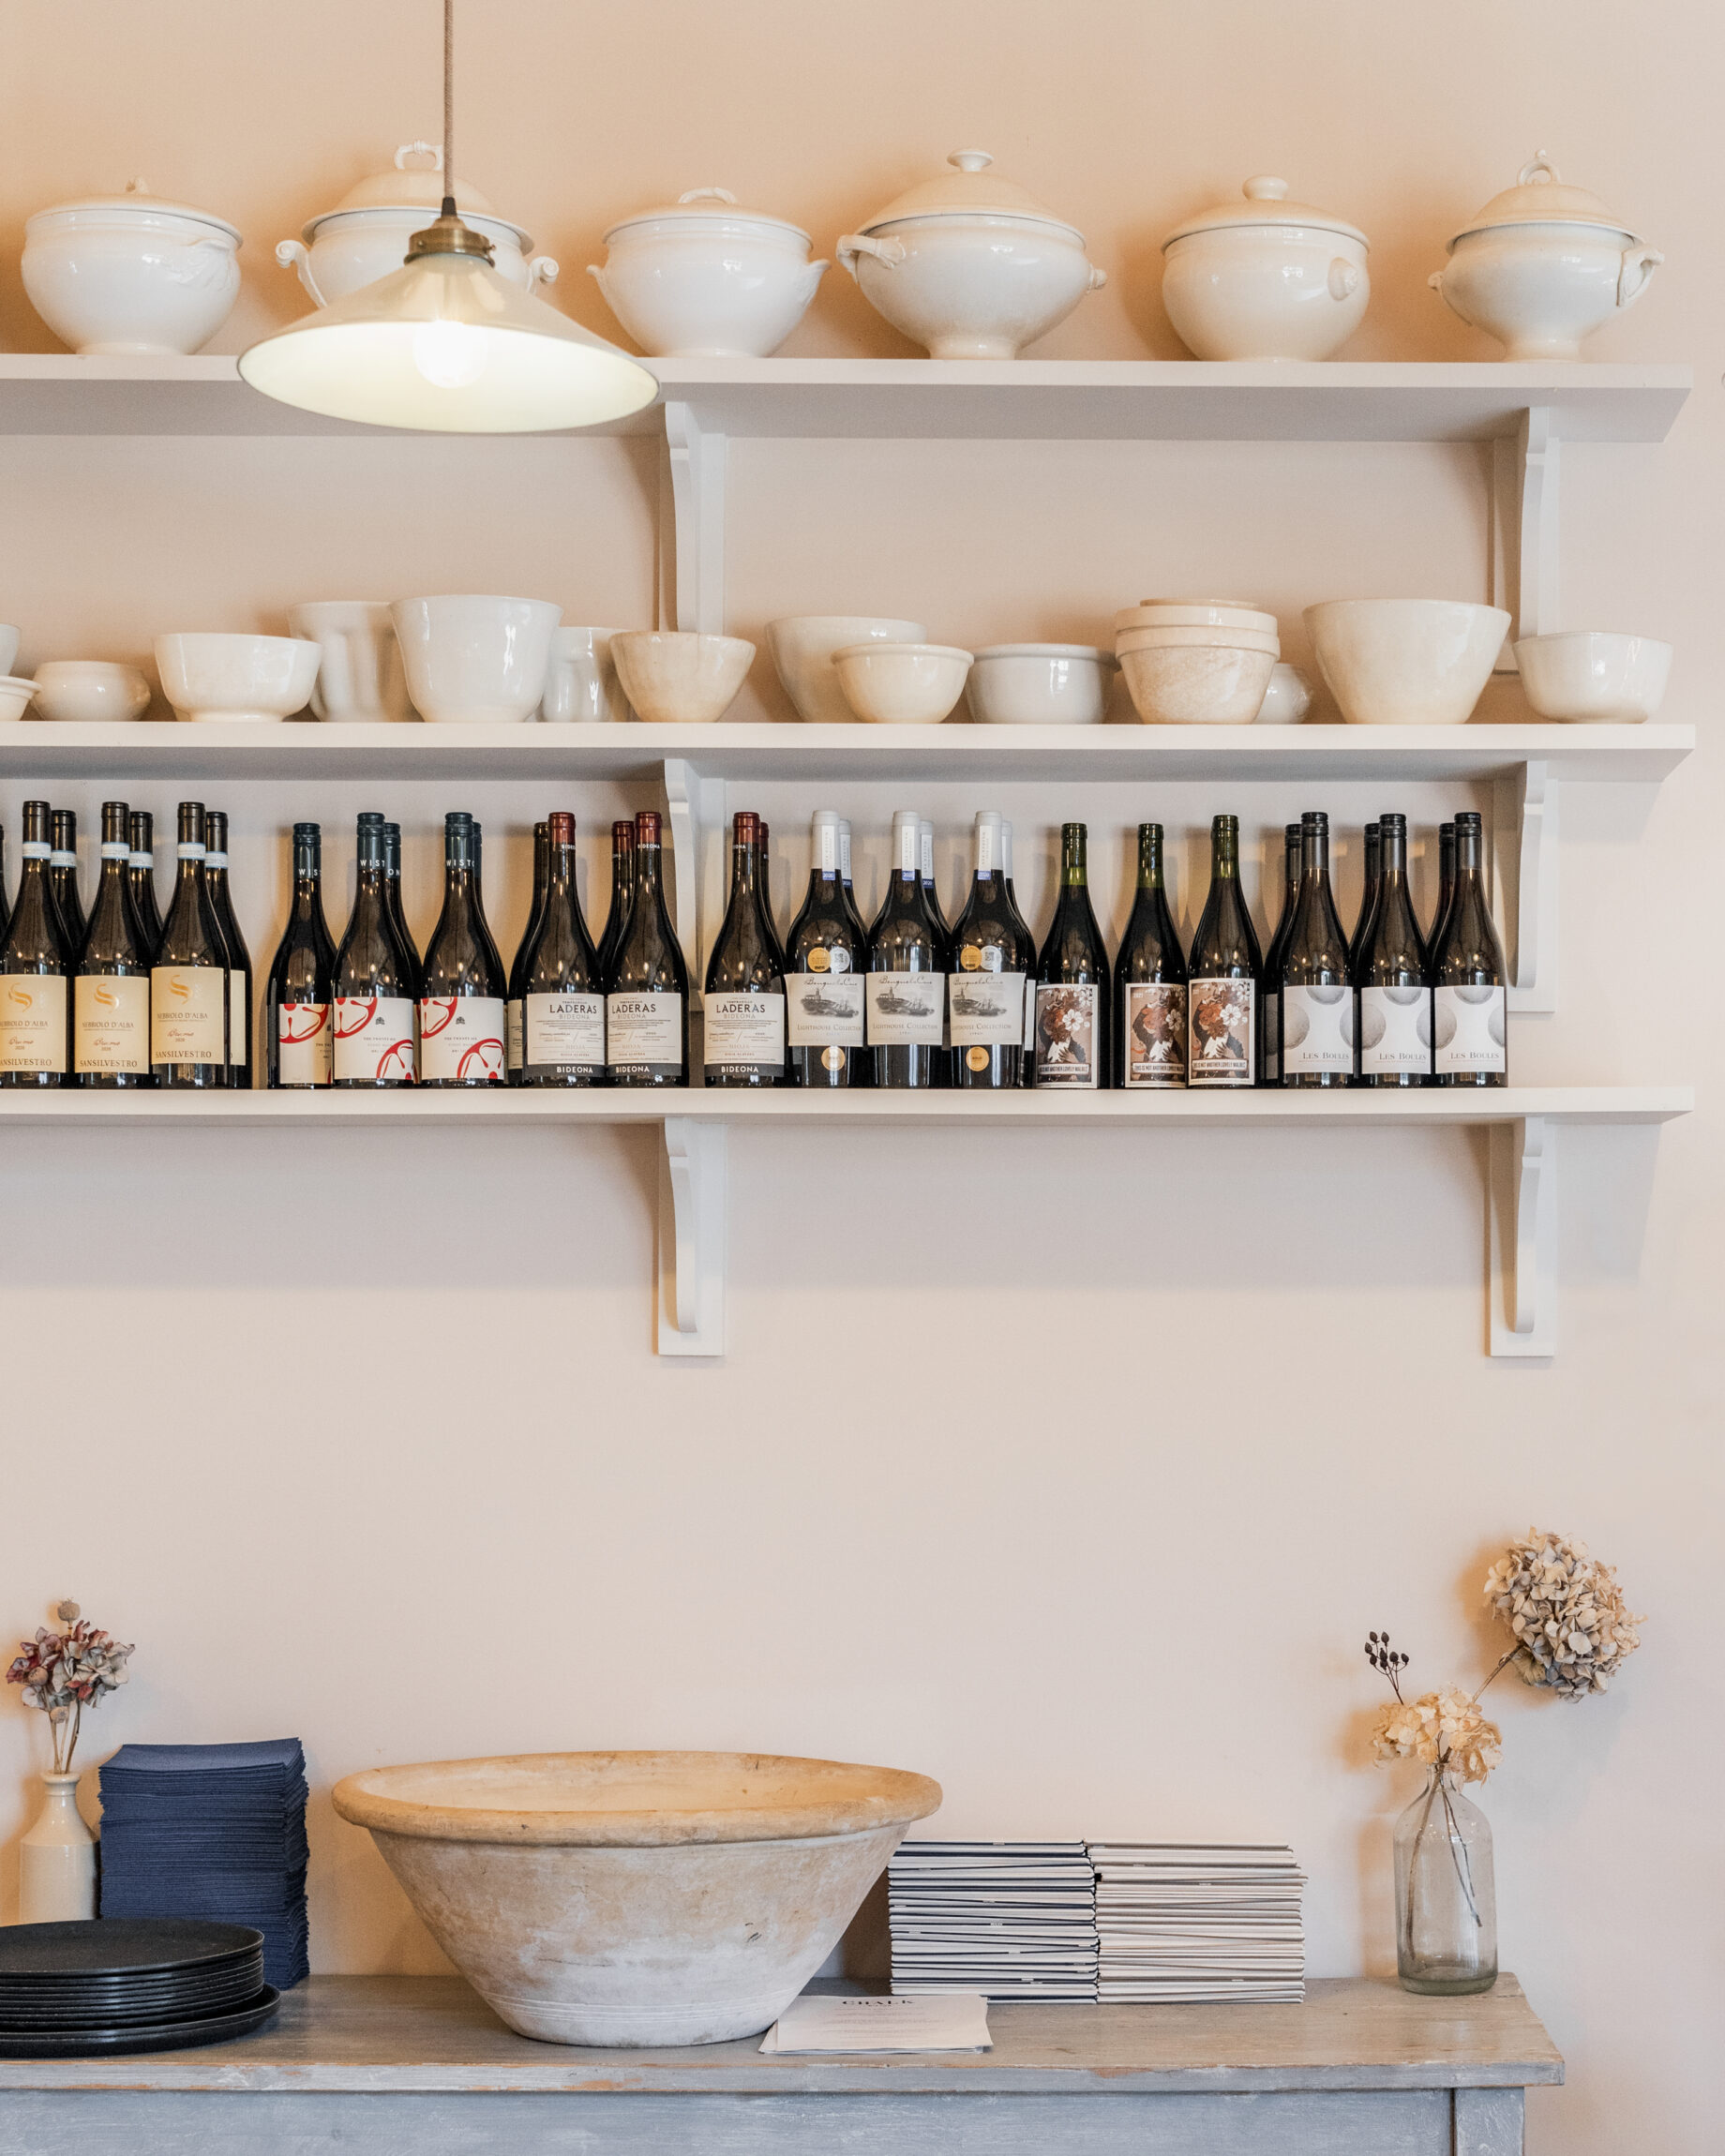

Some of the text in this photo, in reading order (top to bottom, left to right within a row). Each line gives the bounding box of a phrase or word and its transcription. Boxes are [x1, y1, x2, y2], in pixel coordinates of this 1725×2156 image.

[298, 868, 322, 876] WIS
[549, 1004, 597, 1014] LADERAS
[611, 1003, 656, 1013] LADERAS
[716, 1004, 765, 1013] LADERAS
[156, 1050, 212, 1058] SANSILVESTRO
[1323, 1052, 1350, 1060] BOULES
[1380, 1052, 1427, 1060] LES BOULES
[1470, 1051, 1500, 1059] BOULES
[80, 1059, 137, 1068] SANSILVESTRO
